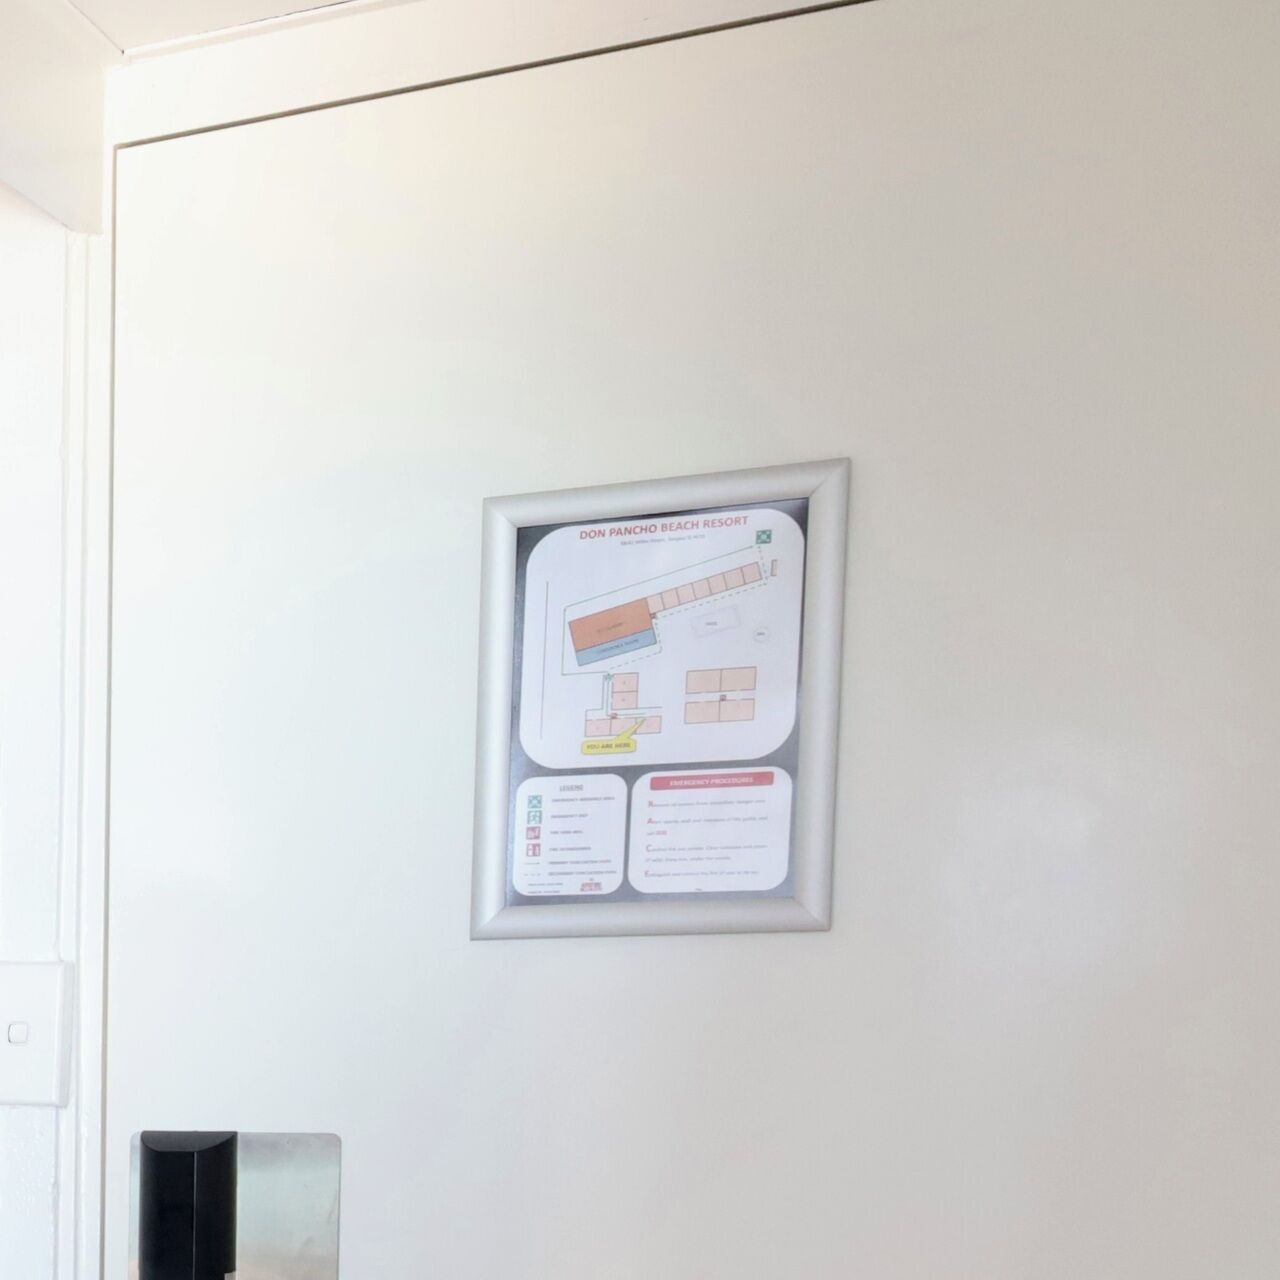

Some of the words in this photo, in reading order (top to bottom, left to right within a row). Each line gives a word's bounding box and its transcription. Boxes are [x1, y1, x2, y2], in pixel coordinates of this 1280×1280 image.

[579, 529, 606, 540] DON
[609, 524, 658, 538] PANCHO
[661, 520, 700, 533] BEACH
[703, 515, 749, 530] RESORT
[669, 779, 710, 787] EMERGENCY
